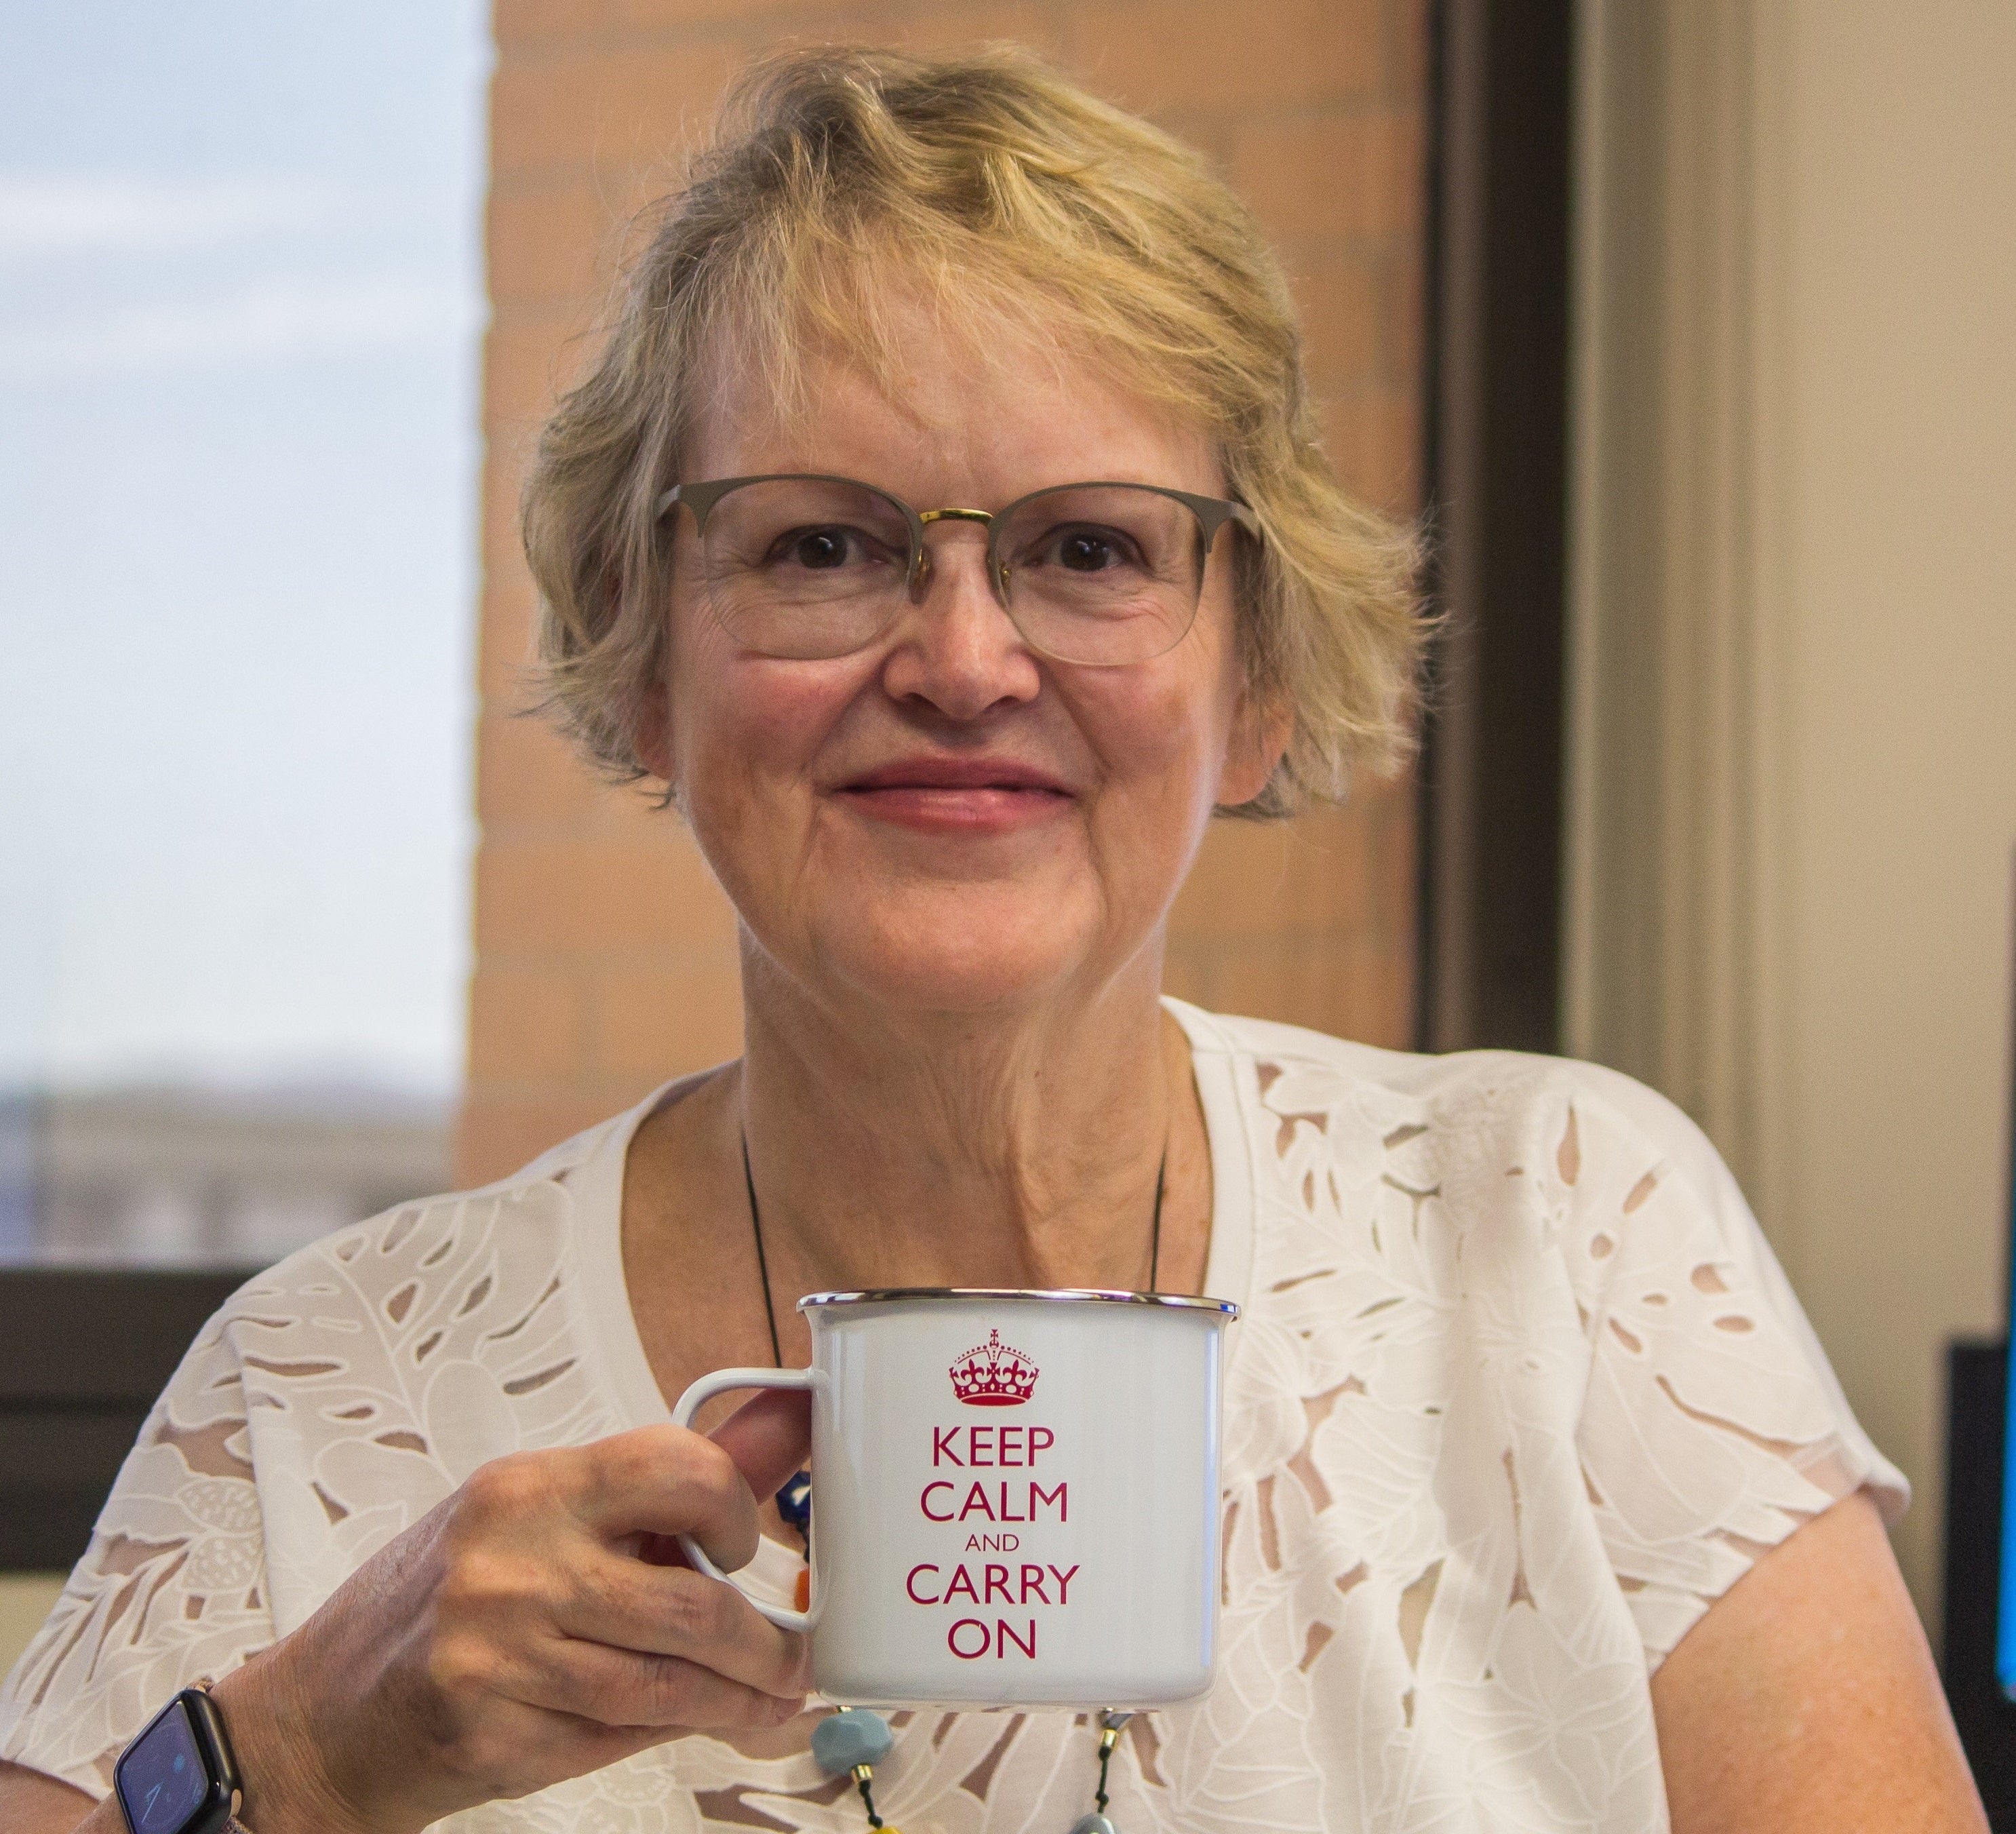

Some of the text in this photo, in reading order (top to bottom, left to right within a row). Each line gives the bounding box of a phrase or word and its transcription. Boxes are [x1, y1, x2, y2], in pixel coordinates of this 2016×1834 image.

[932, 1426, 1055, 1468] KEEP
[920, 1481, 1068, 1523] CALM
[965, 1534, 1020, 1552] AND
[906, 1563, 1080, 1605] CARRY
[947, 1618, 1036, 1660] ON
